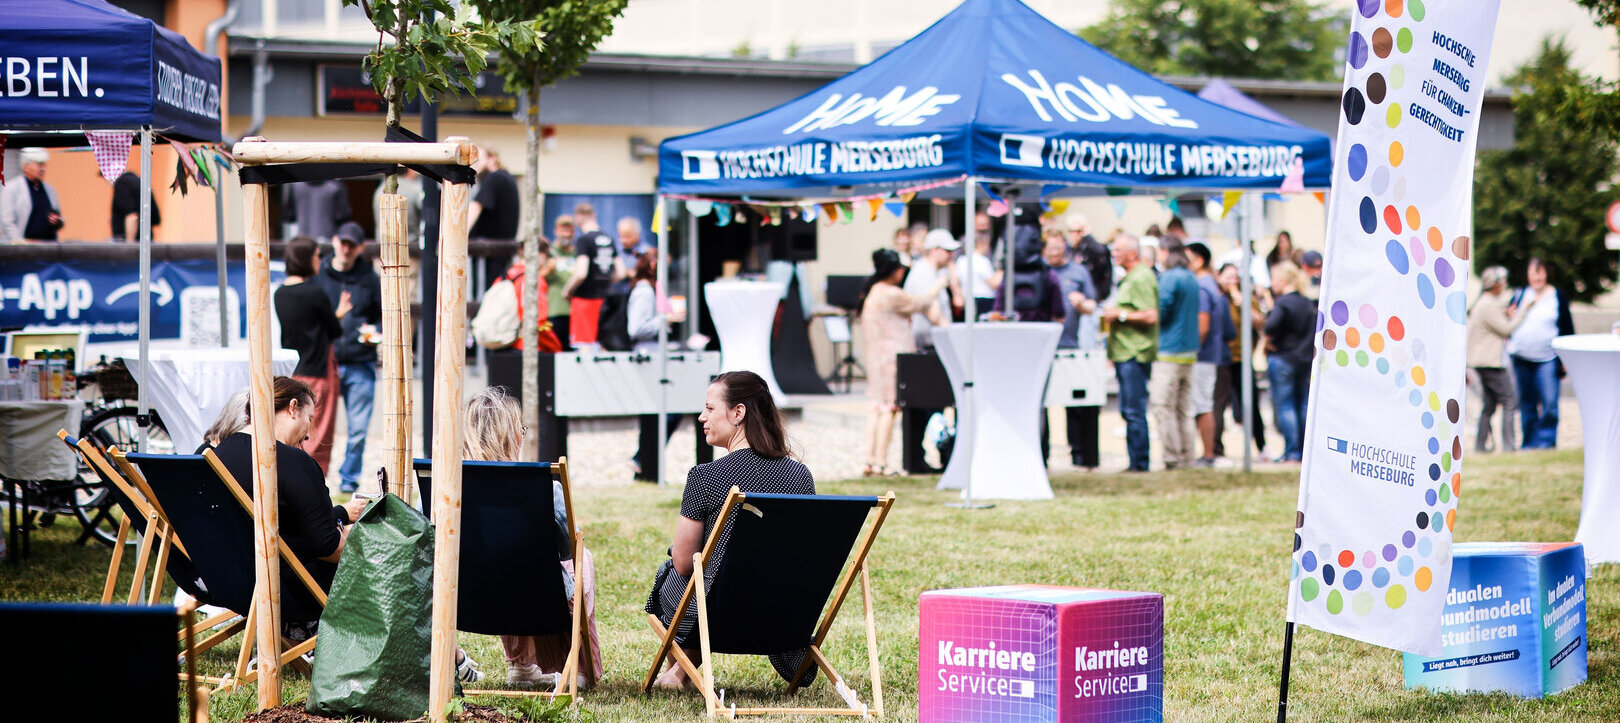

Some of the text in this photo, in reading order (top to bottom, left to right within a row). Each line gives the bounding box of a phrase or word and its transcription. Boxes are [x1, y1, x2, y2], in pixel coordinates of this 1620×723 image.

[0, 57, 105, 98] BEN.
[1421, 80, 1437, 99] FÜR
[830, 134, 943, 173] MERSEBURG
[1048, 138, 1305, 177] HOCHSCHULE MERSEBURG
[1351, 442, 1416, 470] HOCHSCHULE
[1351, 459, 1414, 487] MERSEBURG
[1446, 584, 1502, 606] dualen
[1441, 624, 1517, 647] studieren
[938, 641, 1036, 672] Karriere
[1075, 641, 1148, 671] Karriere
[1429, 661, 1444, 670] Liegt
[1460, 657, 1478, 665] bringt
[1479, 655, 1492, 663] dich
[1493, 651, 1515, 661] weiter!
[937, 669, 1008, 696] Service
[1074, 672, 1129, 698] Service
